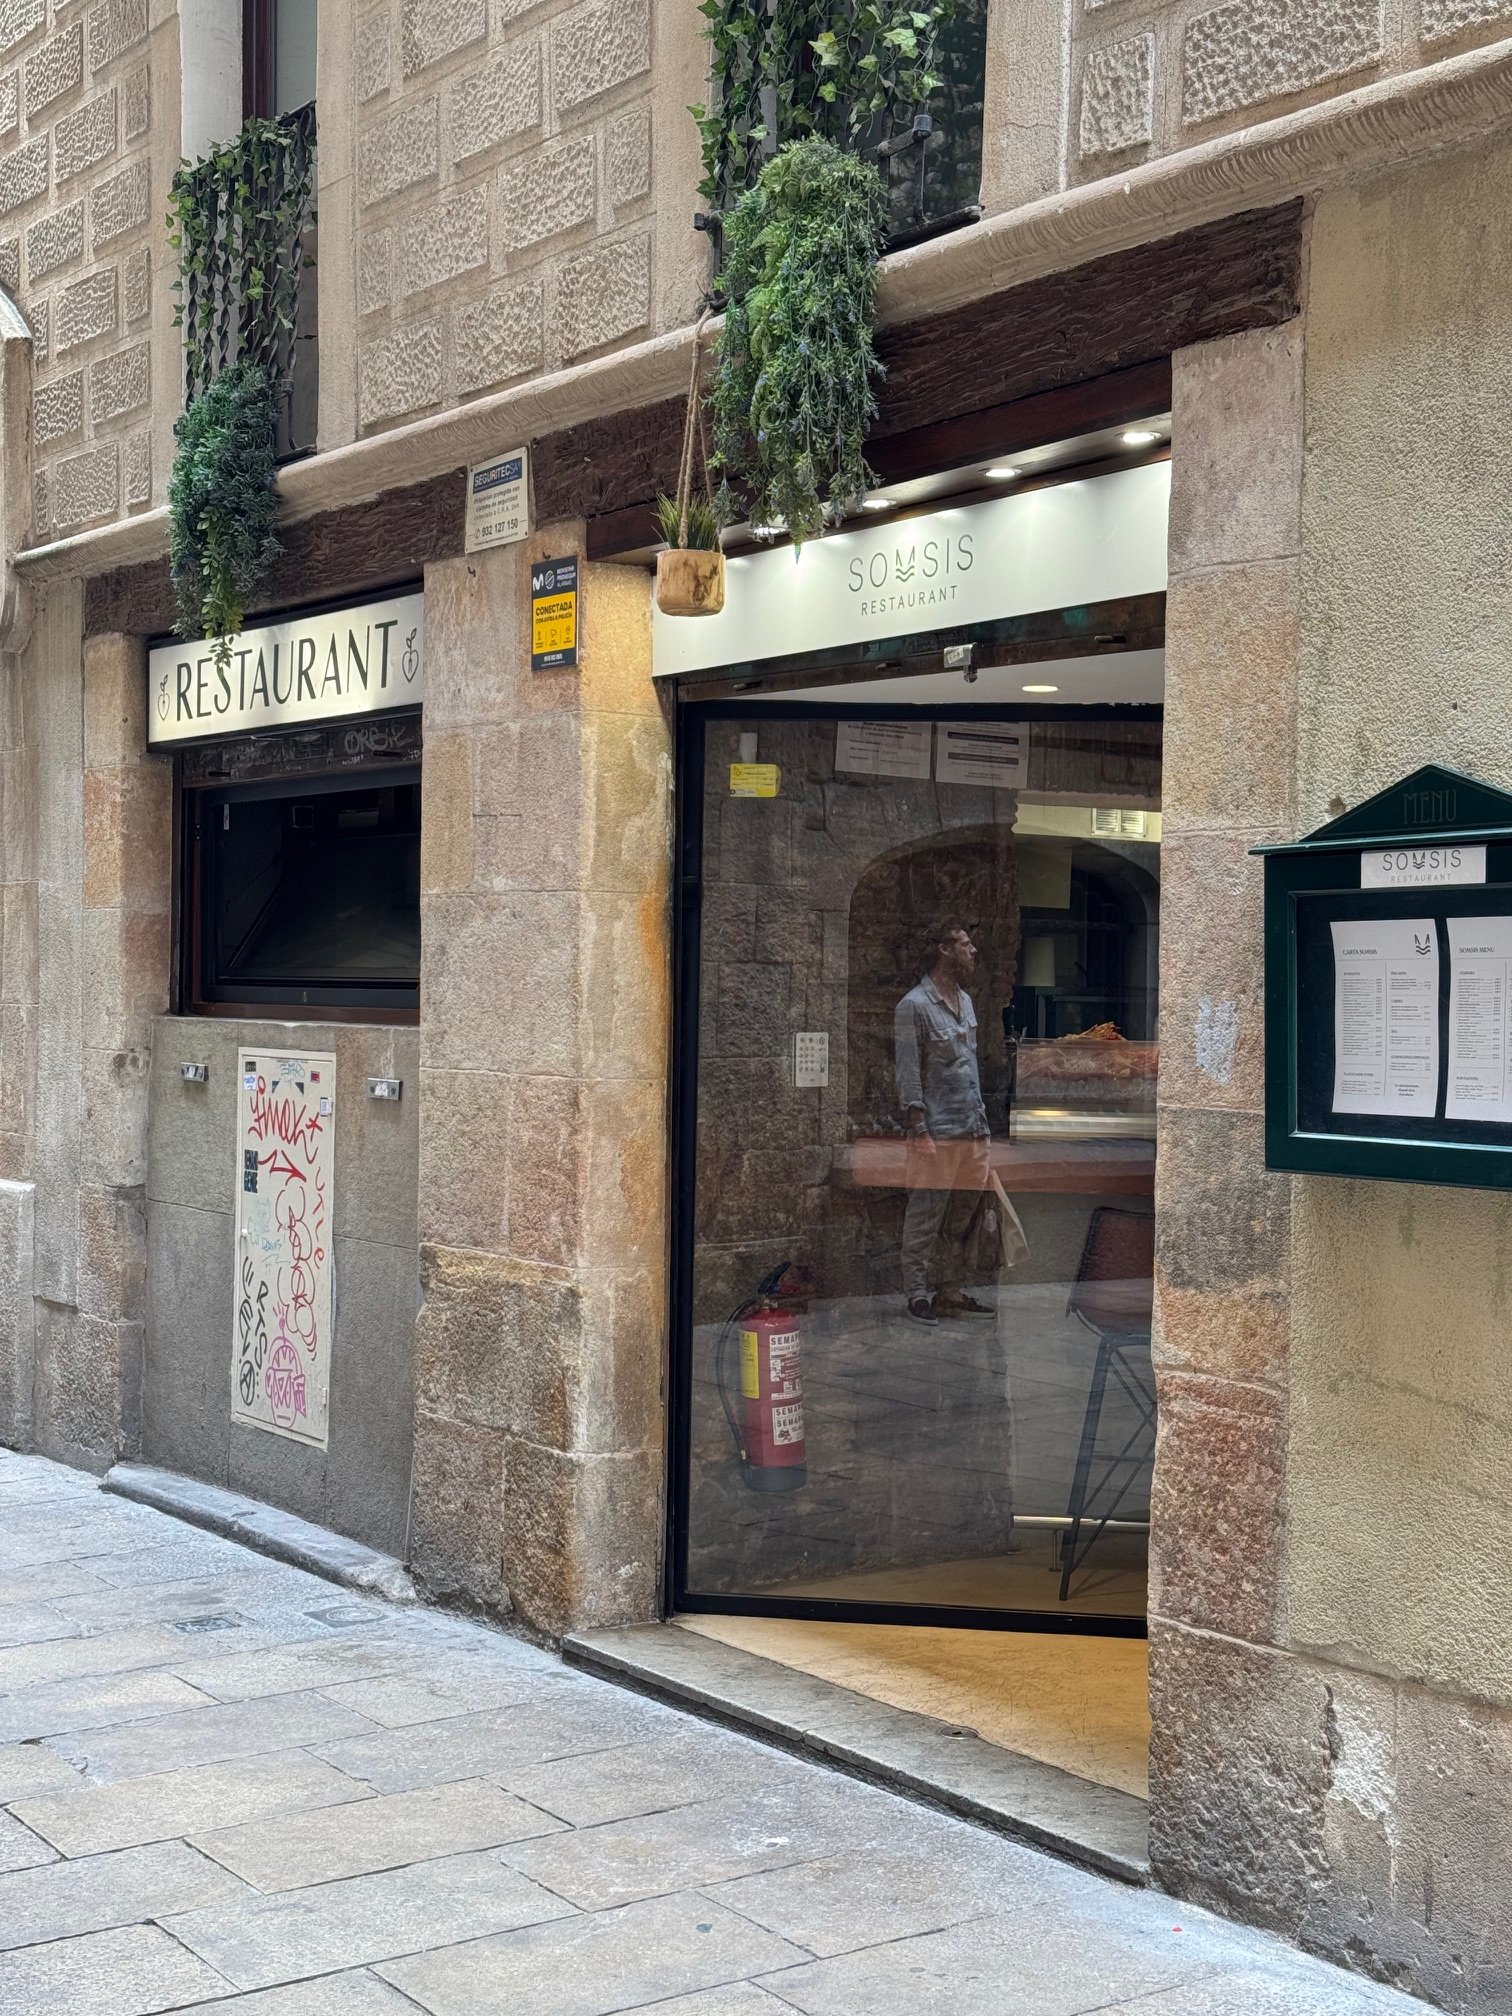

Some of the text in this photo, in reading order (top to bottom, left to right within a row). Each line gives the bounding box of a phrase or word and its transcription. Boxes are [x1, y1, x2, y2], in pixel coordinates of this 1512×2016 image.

[481, 518, 519, 537] 932 127 150
[848, 534, 974, 592] SOMSIS
[535, 600, 573, 617] CONECTADA
[861, 585, 958, 616] RESTAURANT
[176, 619, 399, 722] RESTAURANT
[1403, 789, 1458, 825] MENU
[1382, 849, 1463, 872] SOMSIS
[1391, 872, 1452, 884] RESTAURANT
